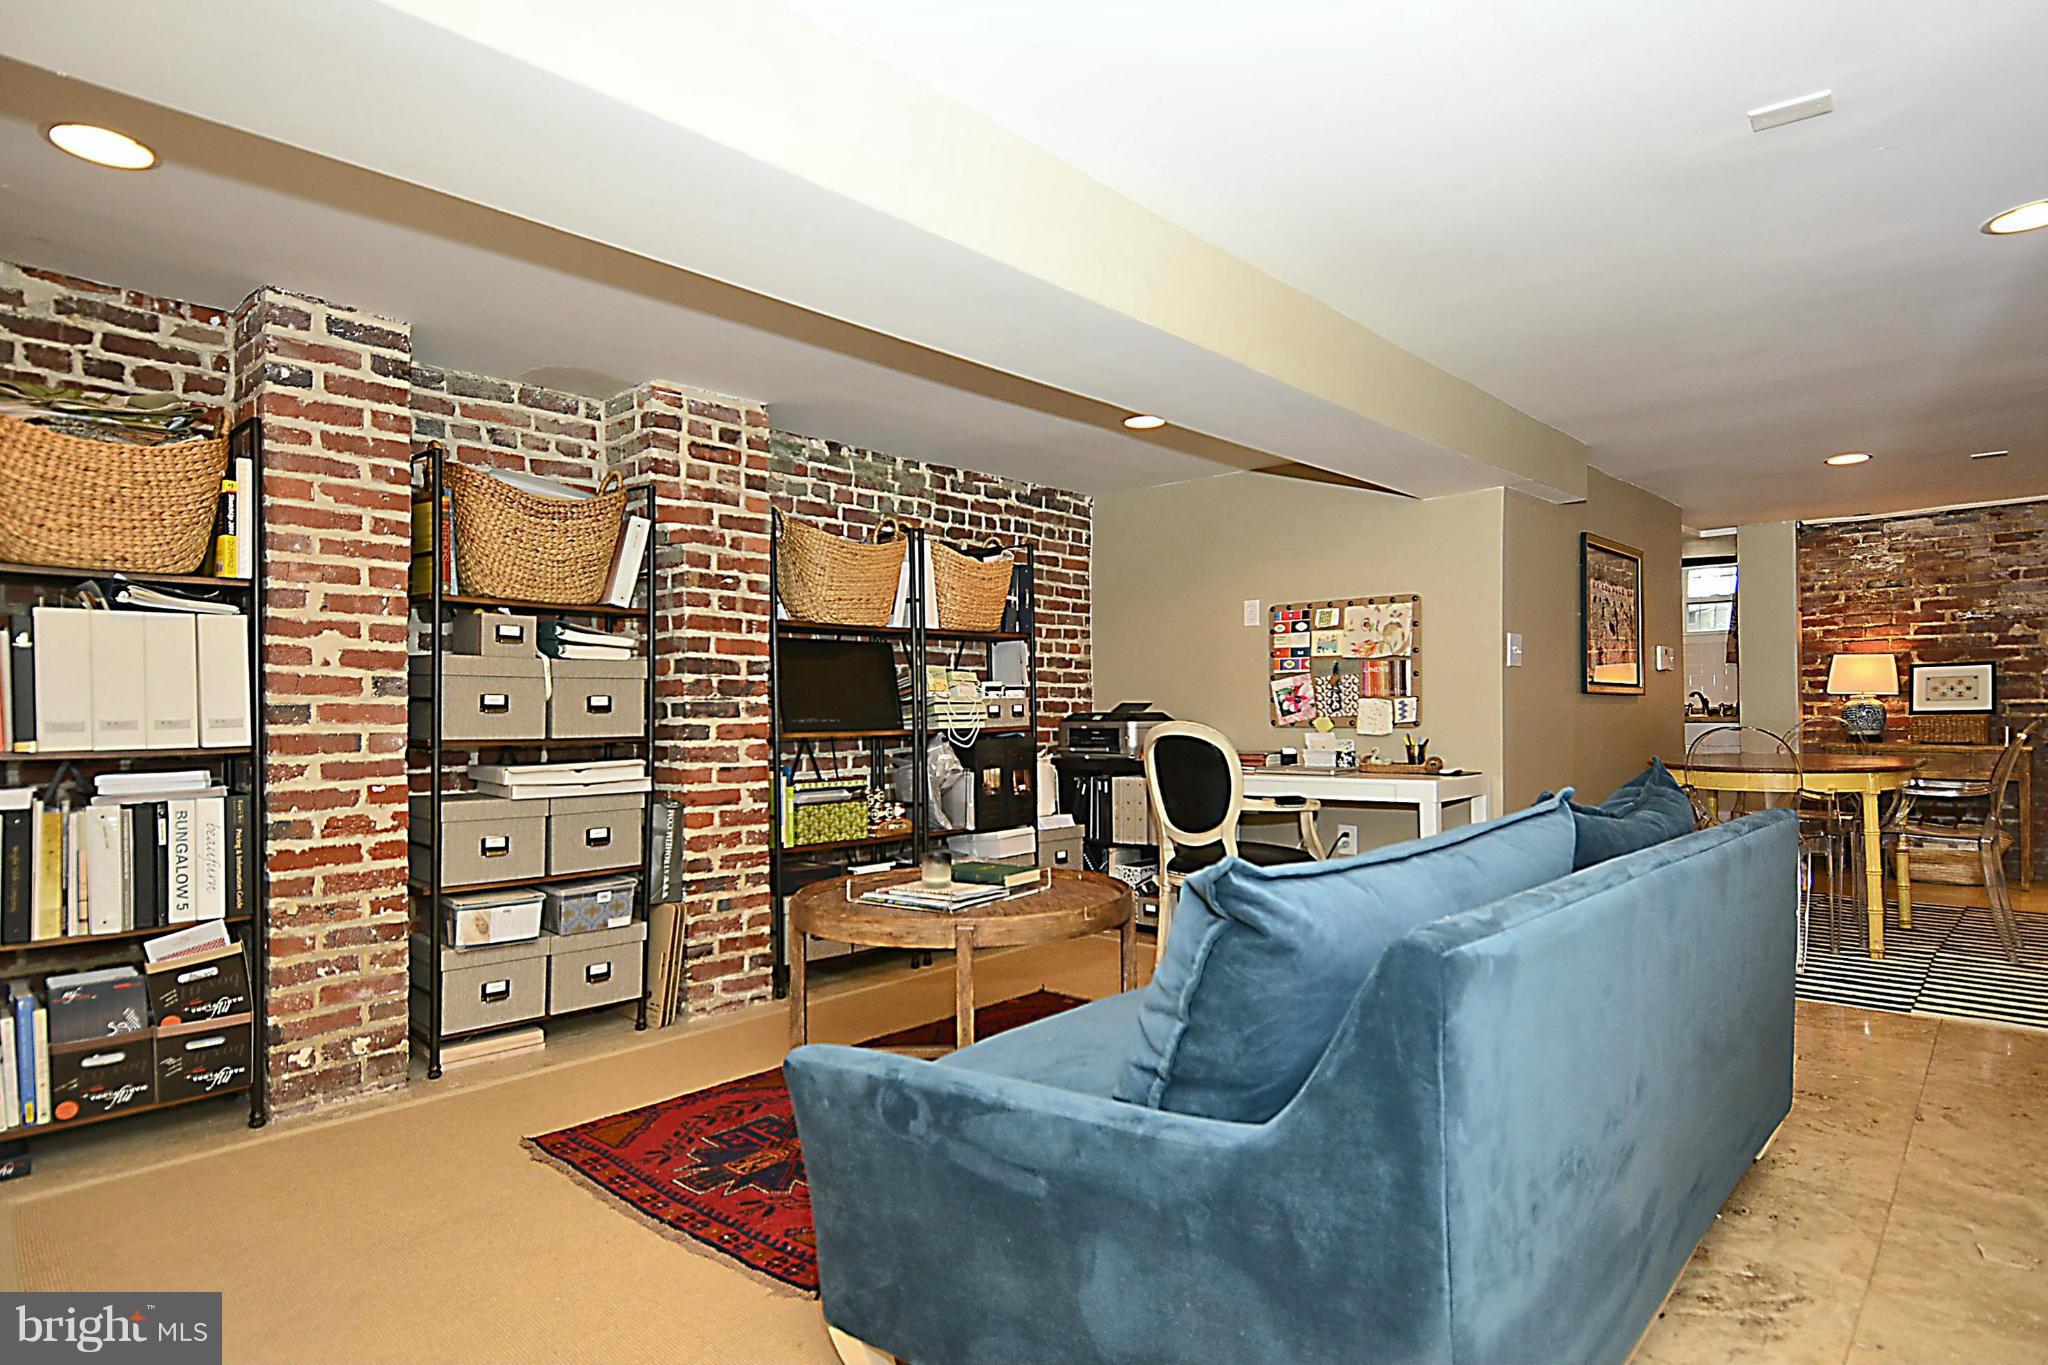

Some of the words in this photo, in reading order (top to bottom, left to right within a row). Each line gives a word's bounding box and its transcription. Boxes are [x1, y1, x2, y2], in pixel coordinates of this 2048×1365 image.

[174, 809, 189, 900] BUNGALOW
[661, 808, 676, 900] WWW.STROHEIM.COM
[175, 903, 190, 911] 5
